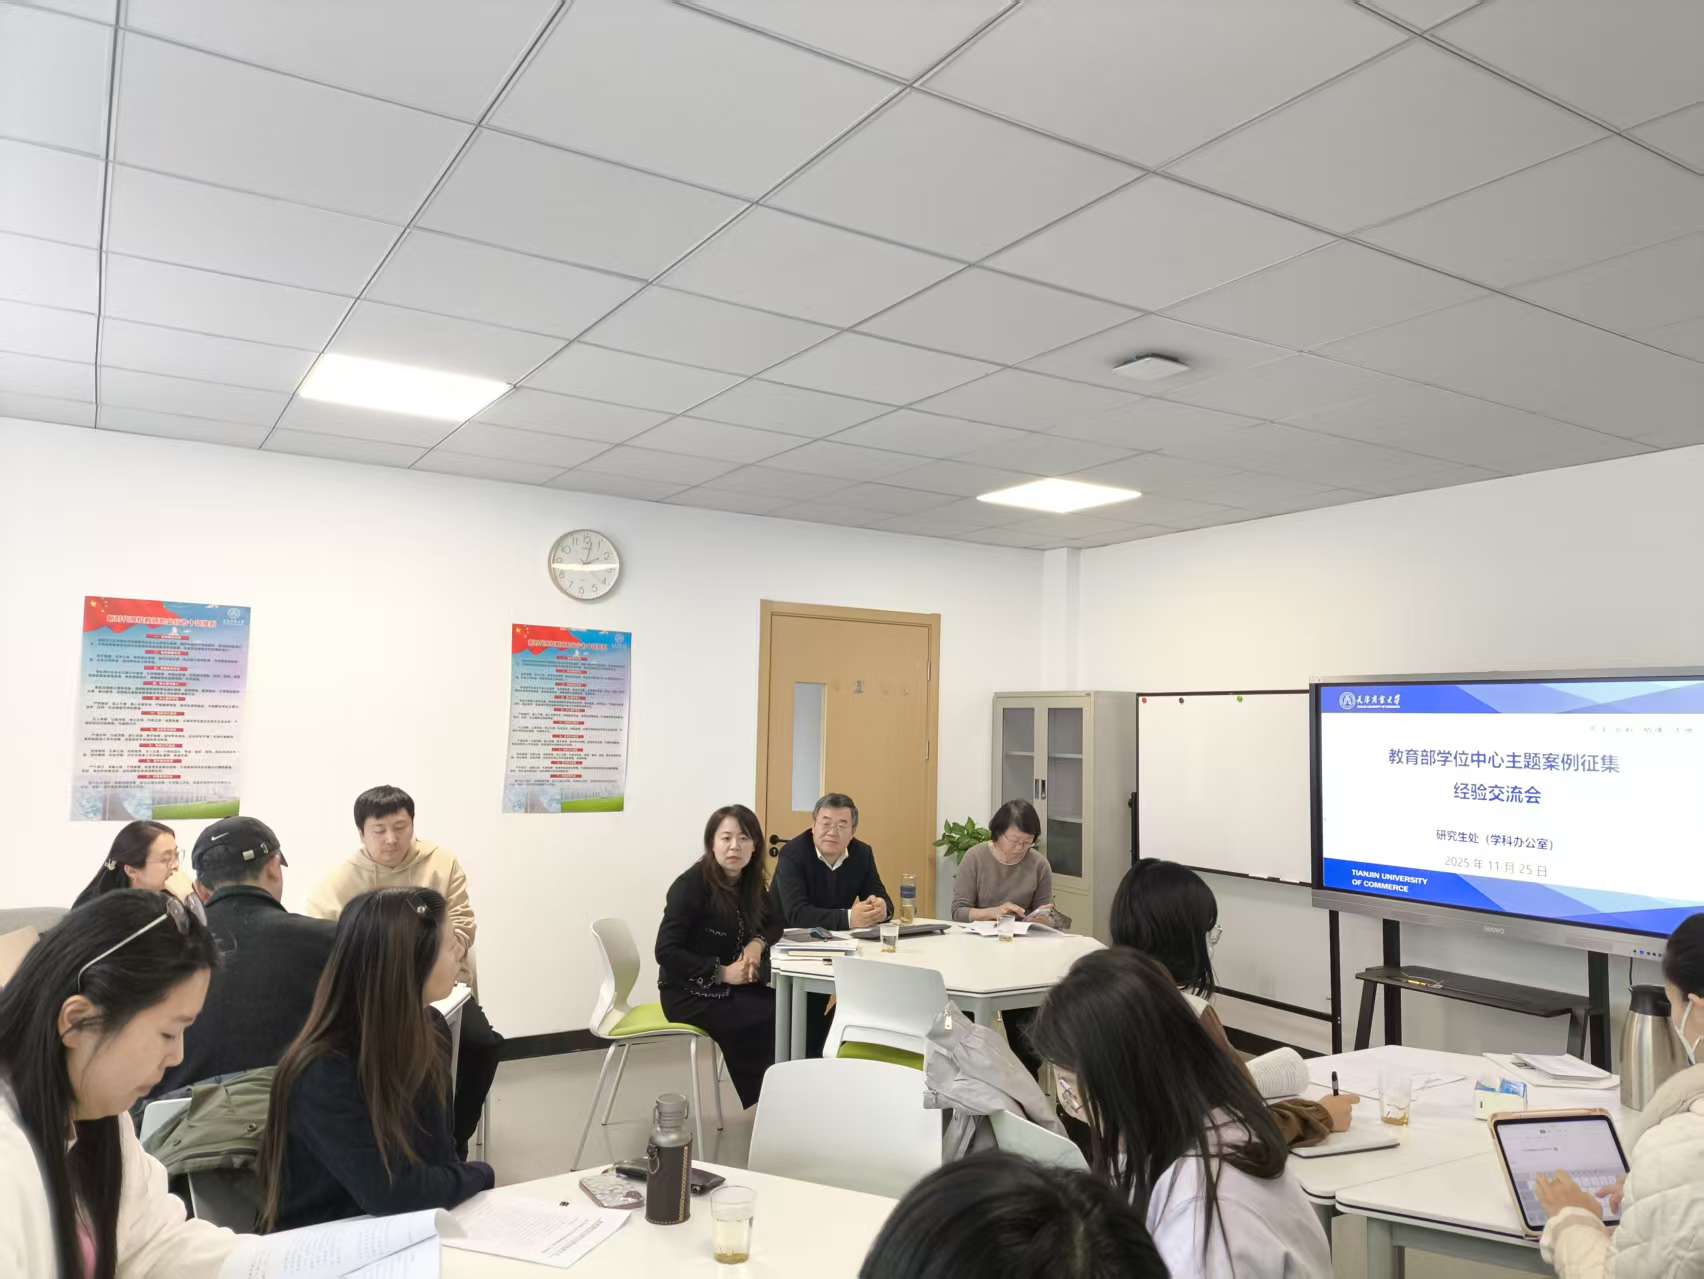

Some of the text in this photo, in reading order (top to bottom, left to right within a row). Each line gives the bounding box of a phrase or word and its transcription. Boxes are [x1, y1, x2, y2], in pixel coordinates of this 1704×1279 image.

[1388, 748, 1620, 774] 教育部学位中心主题案例征集
[1453, 782, 1542, 805] 经验交流会
[1351, 869, 1428, 885] TIANJIN UNIVERSITY
[1444, 856, 1470, 868] 2025
[1519, 864, 1533, 875] 25
[1537, 865, 1547, 878] 日
[1351, 879, 1409, 892] OF COMMERCE
